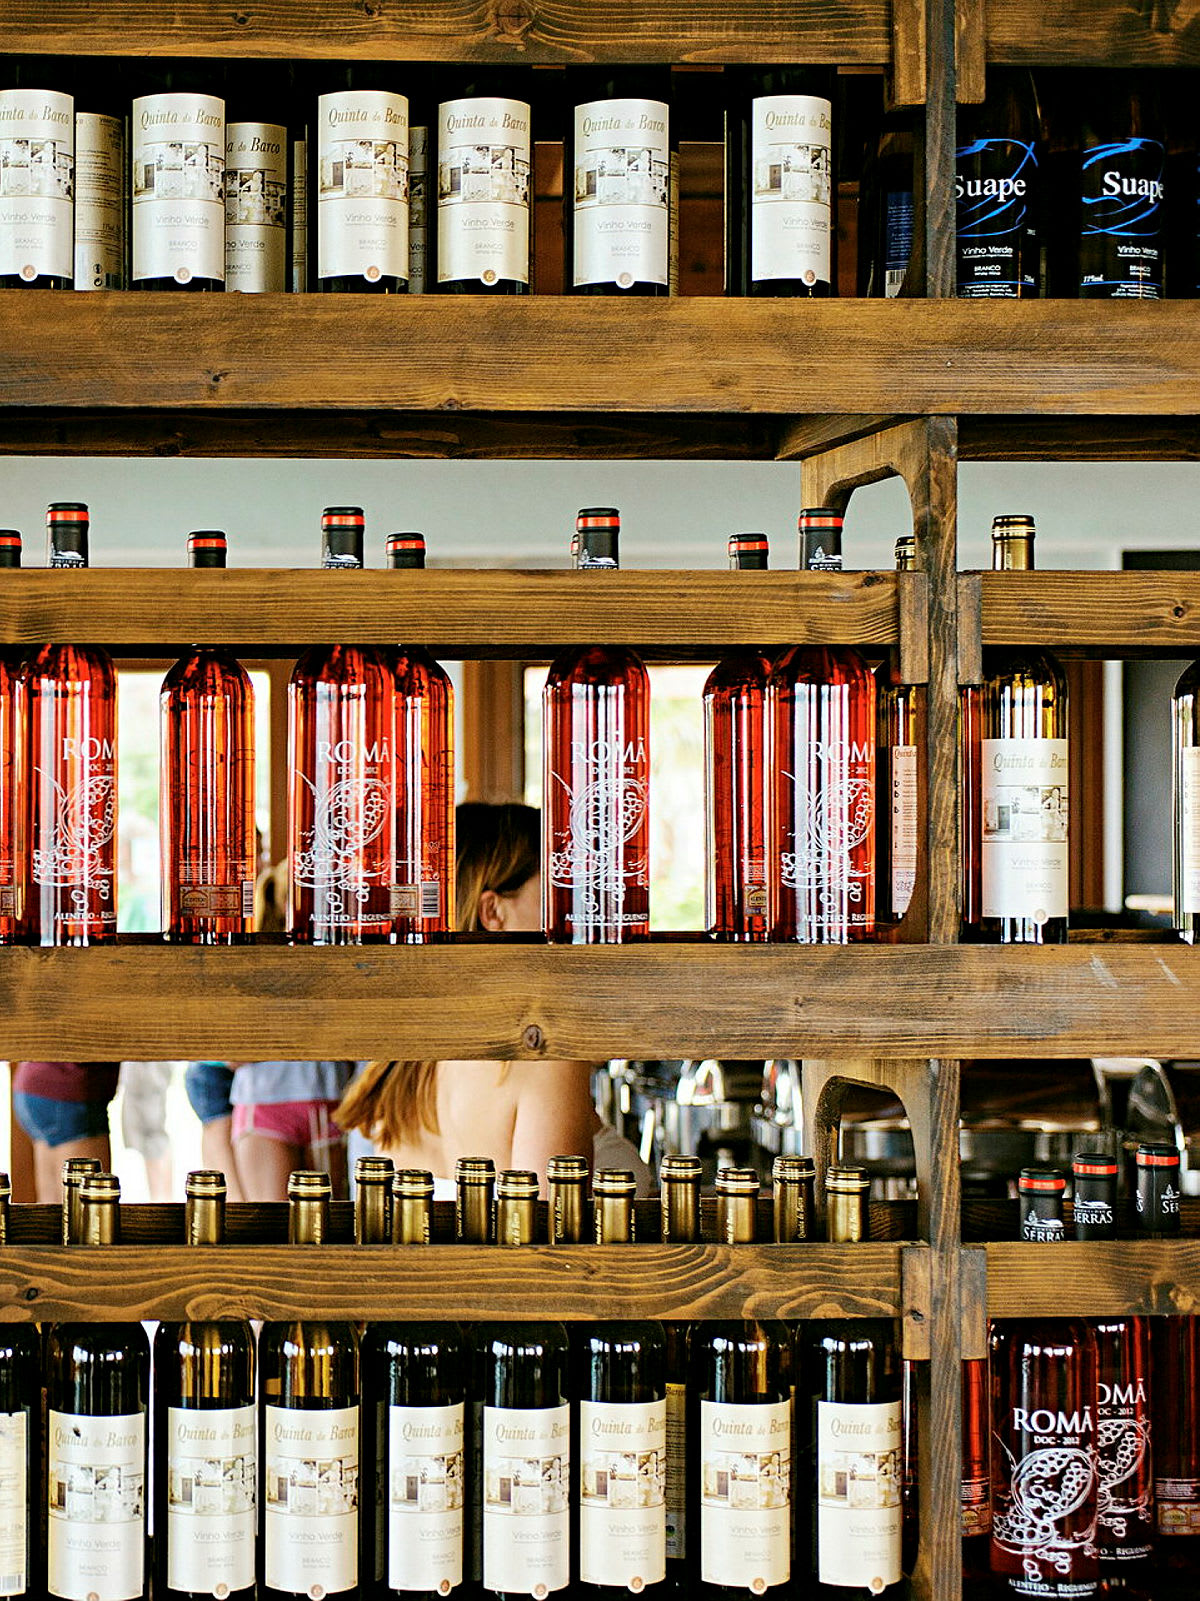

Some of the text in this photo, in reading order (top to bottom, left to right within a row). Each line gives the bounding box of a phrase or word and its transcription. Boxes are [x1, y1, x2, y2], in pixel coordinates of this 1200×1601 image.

[42, 106, 70, 124] Barco
[141, 110, 178, 130] Quinta
[195, 109, 221, 128] Barco
[329, 107, 368, 127] Quinta
[447, 114, 485, 134] Quinta
[765, 111, 805, 130] Quinta
[583, 117, 621, 136] Quinta
[639, 115, 665, 133] Barco
[250, 136, 280, 154] Barco
[955, 175, 1026, 202] Suape
[1103, 171, 1164, 203] Suape
[963, 247, 986, 255] Vinho
[63, 738, 115, 760] ROM
[317, 737, 390, 763] ROMÃ
[571, 737, 646, 763] ROMÃ
[994, 753, 1034, 772] Quinta
[1097, 1378, 1146, 1405] OMÃ
[592, 1418, 632, 1437] Quinta
[713, 1418, 752, 1437] Quinta
[831, 1418, 871, 1437] Quinta
[1013, 1406, 1093, 1434] ROMÃ
[105, 1431, 138, 1448] Barco
[178, 1424, 217, 1443] Quinta
[274, 1423, 312, 1442] Quinta
[402, 1421, 442, 1442] Quinta
[495, 1423, 536, 1443] Quinta
